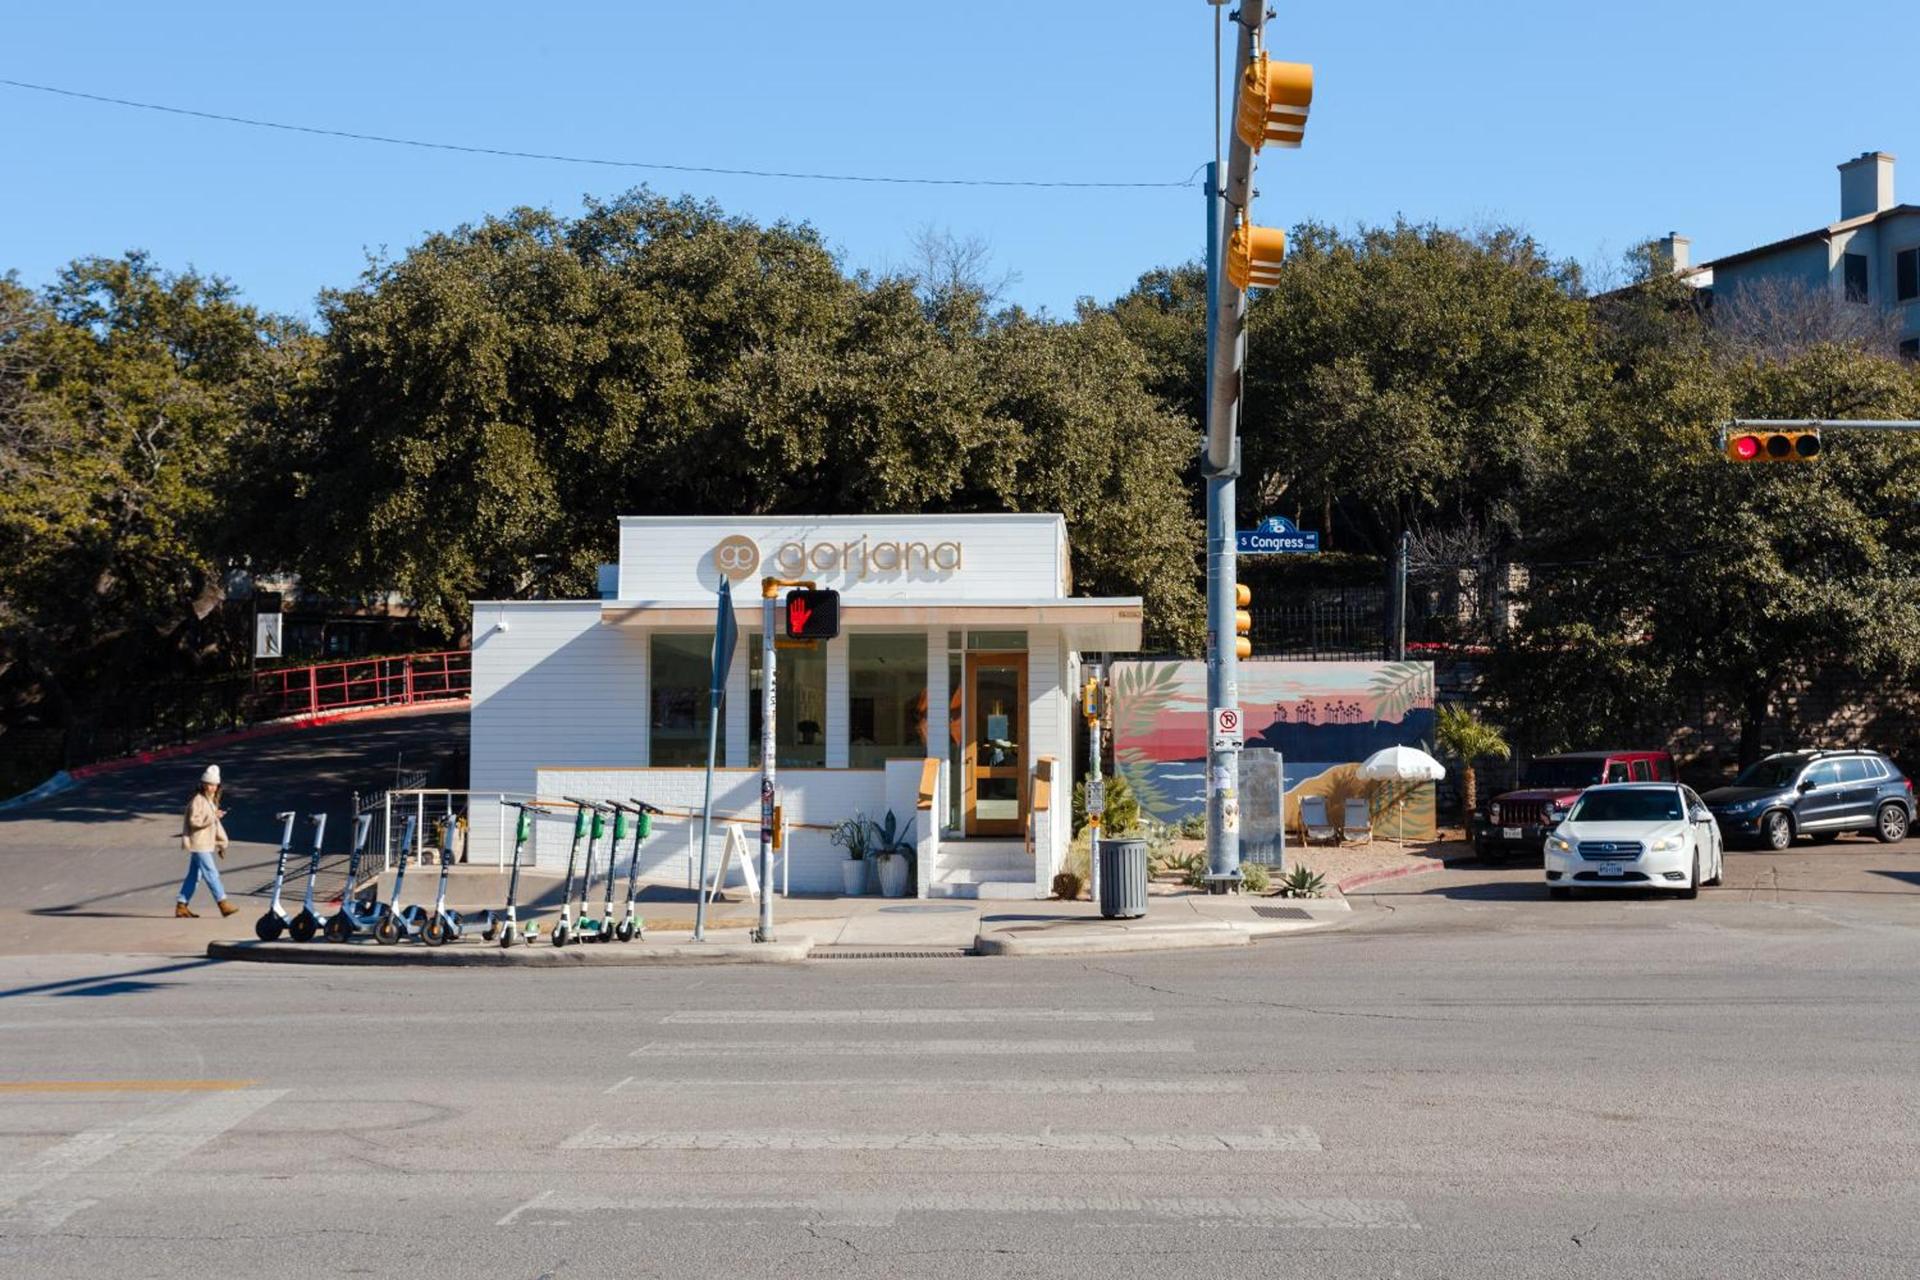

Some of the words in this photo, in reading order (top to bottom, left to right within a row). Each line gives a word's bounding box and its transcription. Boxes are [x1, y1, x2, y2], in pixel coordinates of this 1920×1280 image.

[778, 533, 962, 579] gorjana
[1241, 537, 1248, 546] S
[1250, 536, 1304, 550] Congress
